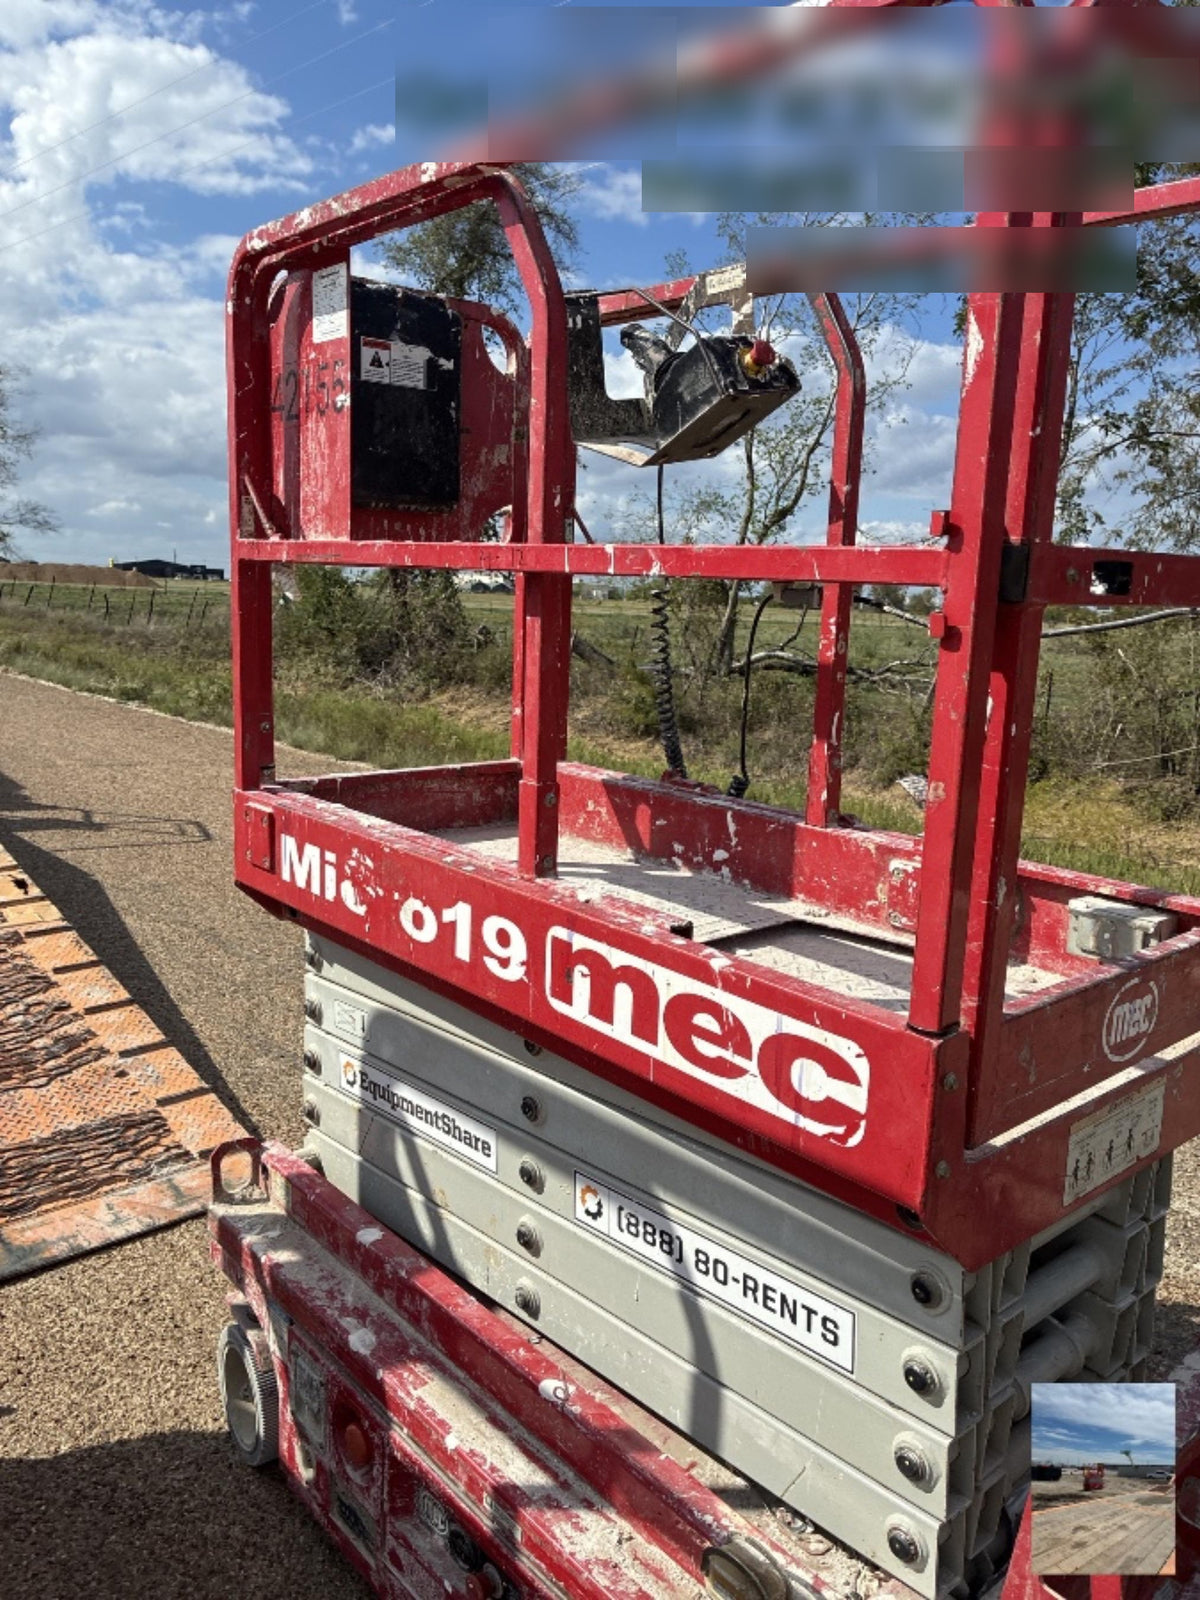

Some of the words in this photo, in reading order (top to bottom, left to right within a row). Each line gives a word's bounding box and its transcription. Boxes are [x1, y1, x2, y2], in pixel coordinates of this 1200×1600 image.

[550, 934, 866, 1127] mec
[359, 1071, 492, 1158] EquipmentShare
[617, 1205, 684, 1264] (888)
[694, 1248, 839, 1347] 80-RENTS
